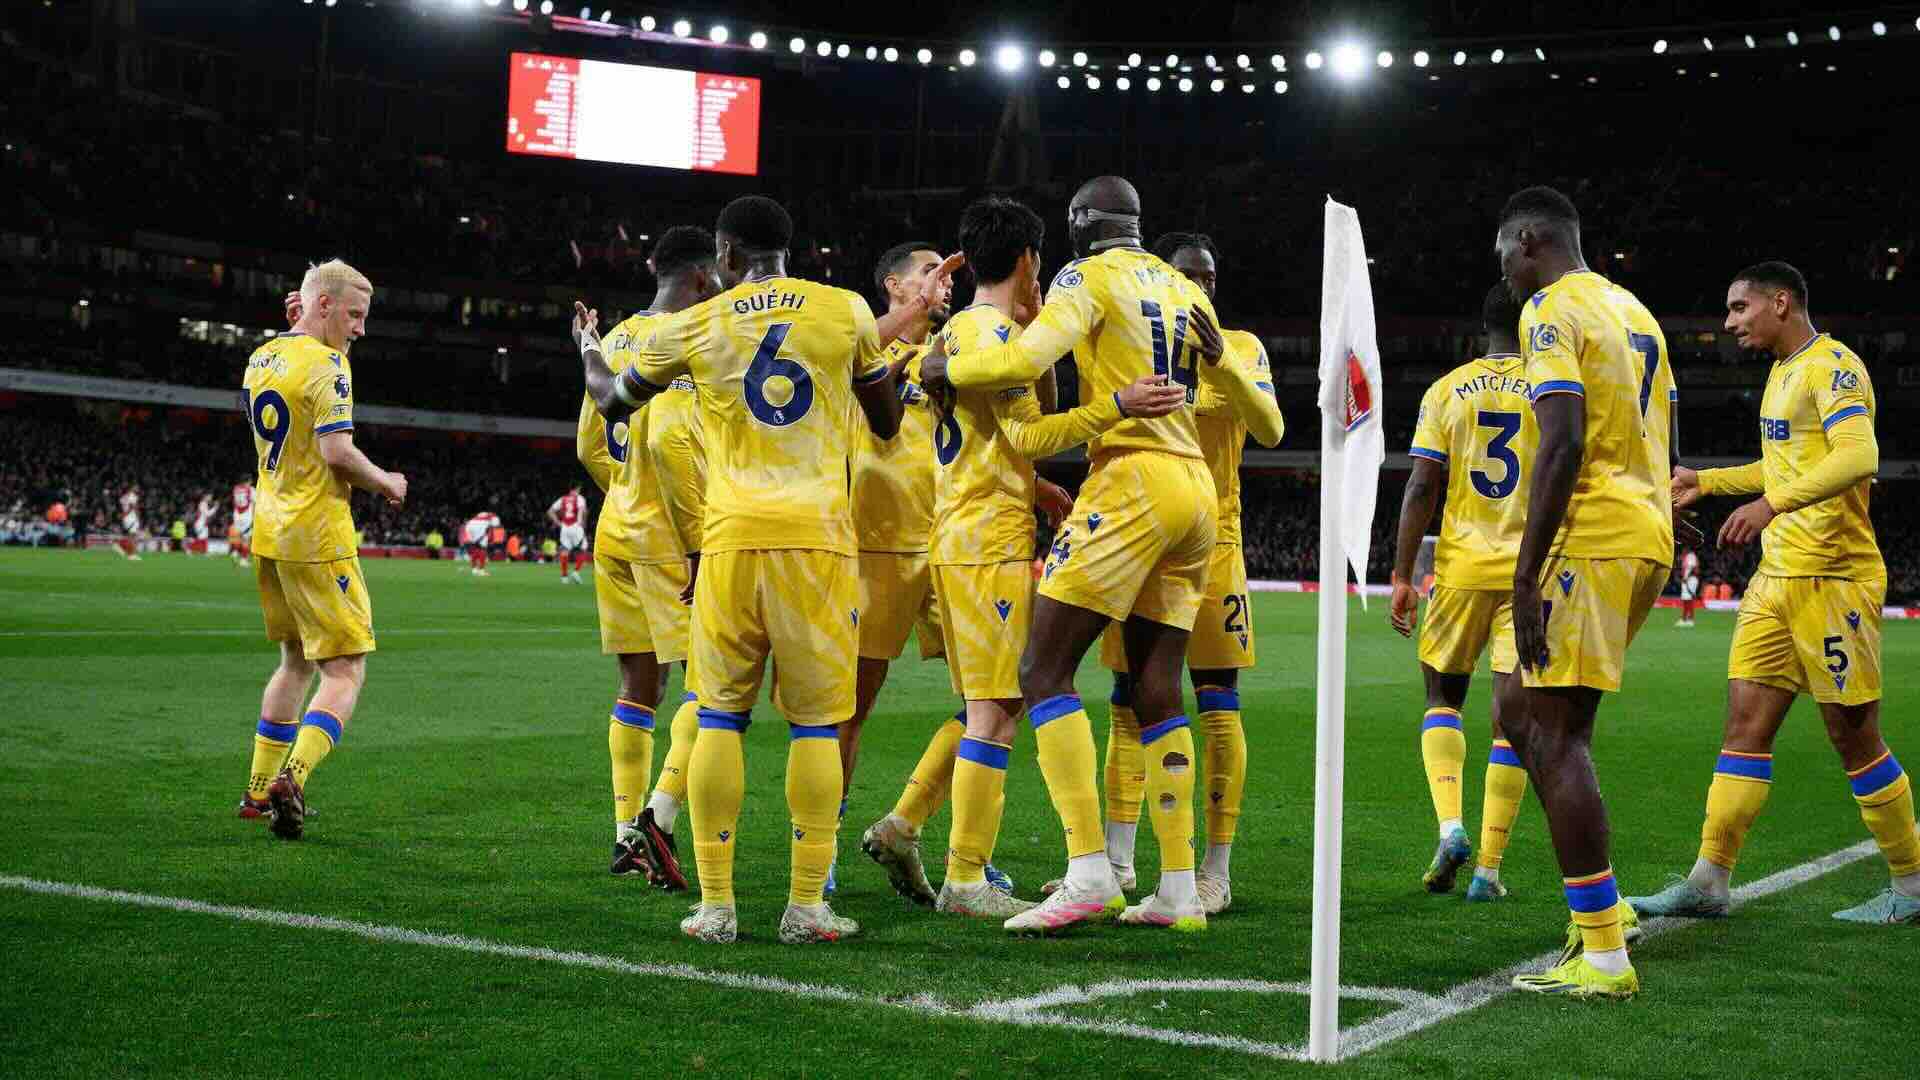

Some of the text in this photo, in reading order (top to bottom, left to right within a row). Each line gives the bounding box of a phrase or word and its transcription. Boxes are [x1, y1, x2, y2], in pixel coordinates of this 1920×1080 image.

[734, 289, 806, 314] GUÉHI
[743, 322, 815, 428] 6
[1627, 331, 1660, 438] 7
[1469, 409, 1523, 499] 3
[1223, 594, 1249, 633] 21
[1823, 635, 1849, 674] 5
